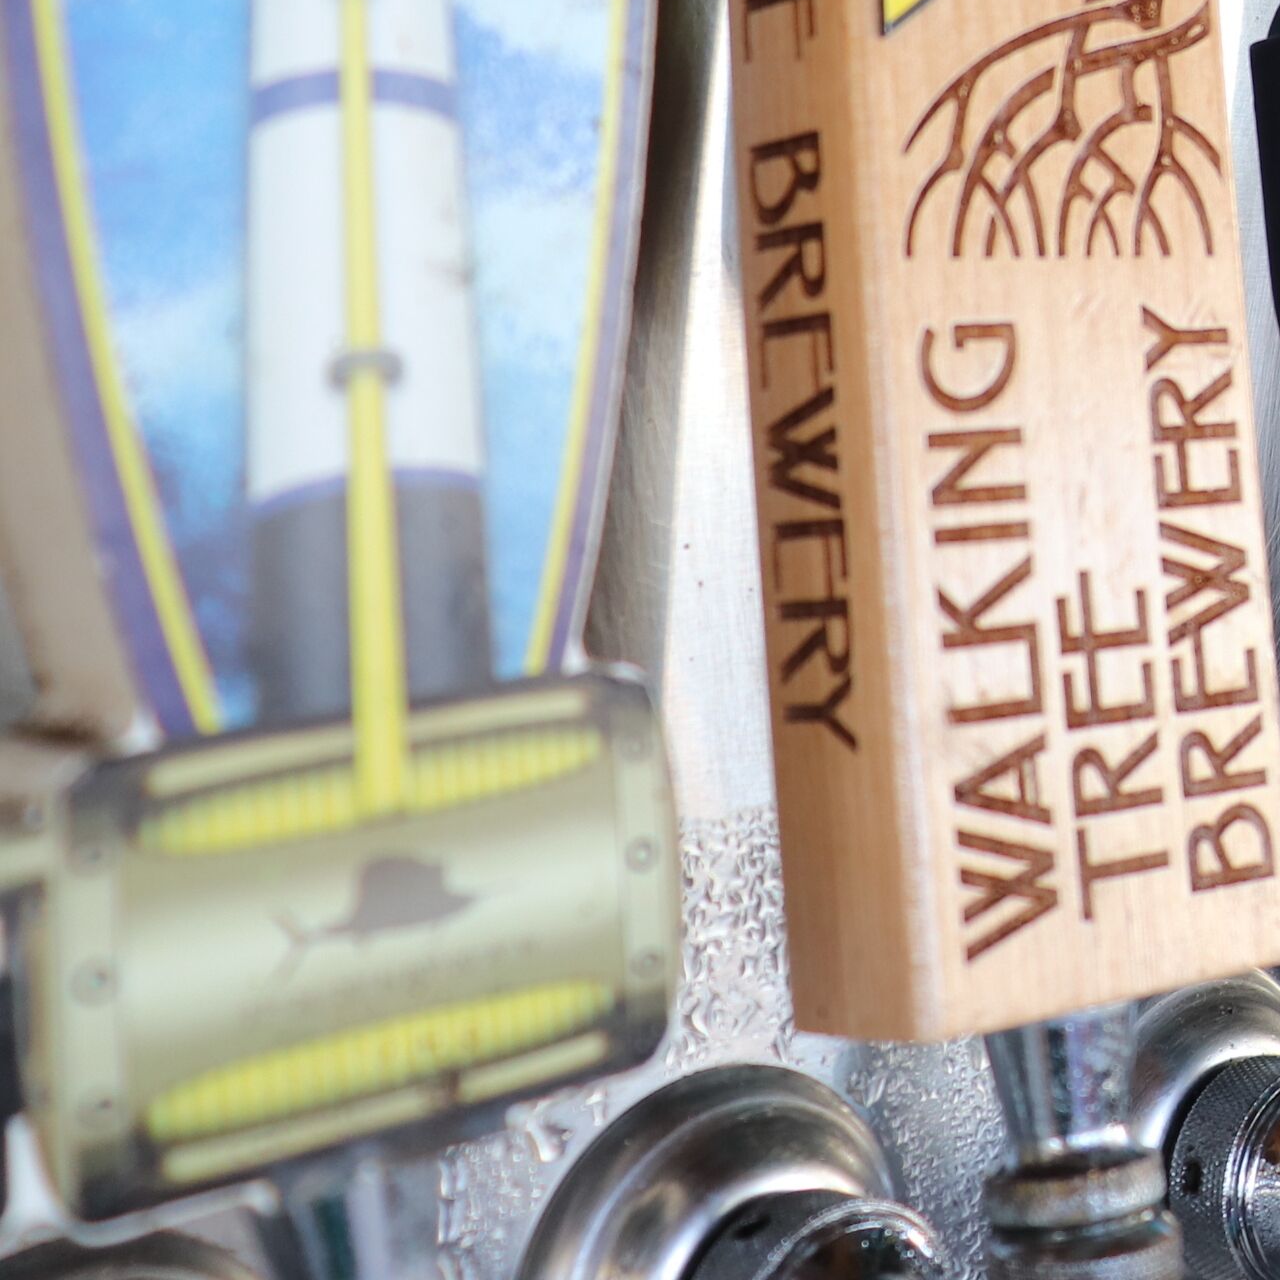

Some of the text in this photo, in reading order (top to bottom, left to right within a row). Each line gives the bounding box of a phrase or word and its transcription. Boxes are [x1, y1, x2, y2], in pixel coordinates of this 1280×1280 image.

[750, 129, 859, 754] BREWERY
[922, 322, 1060, 963] WALKING
[1141, 304, 1275, 893] BREWERY
[1056, 571, 1169, 920] TREE
